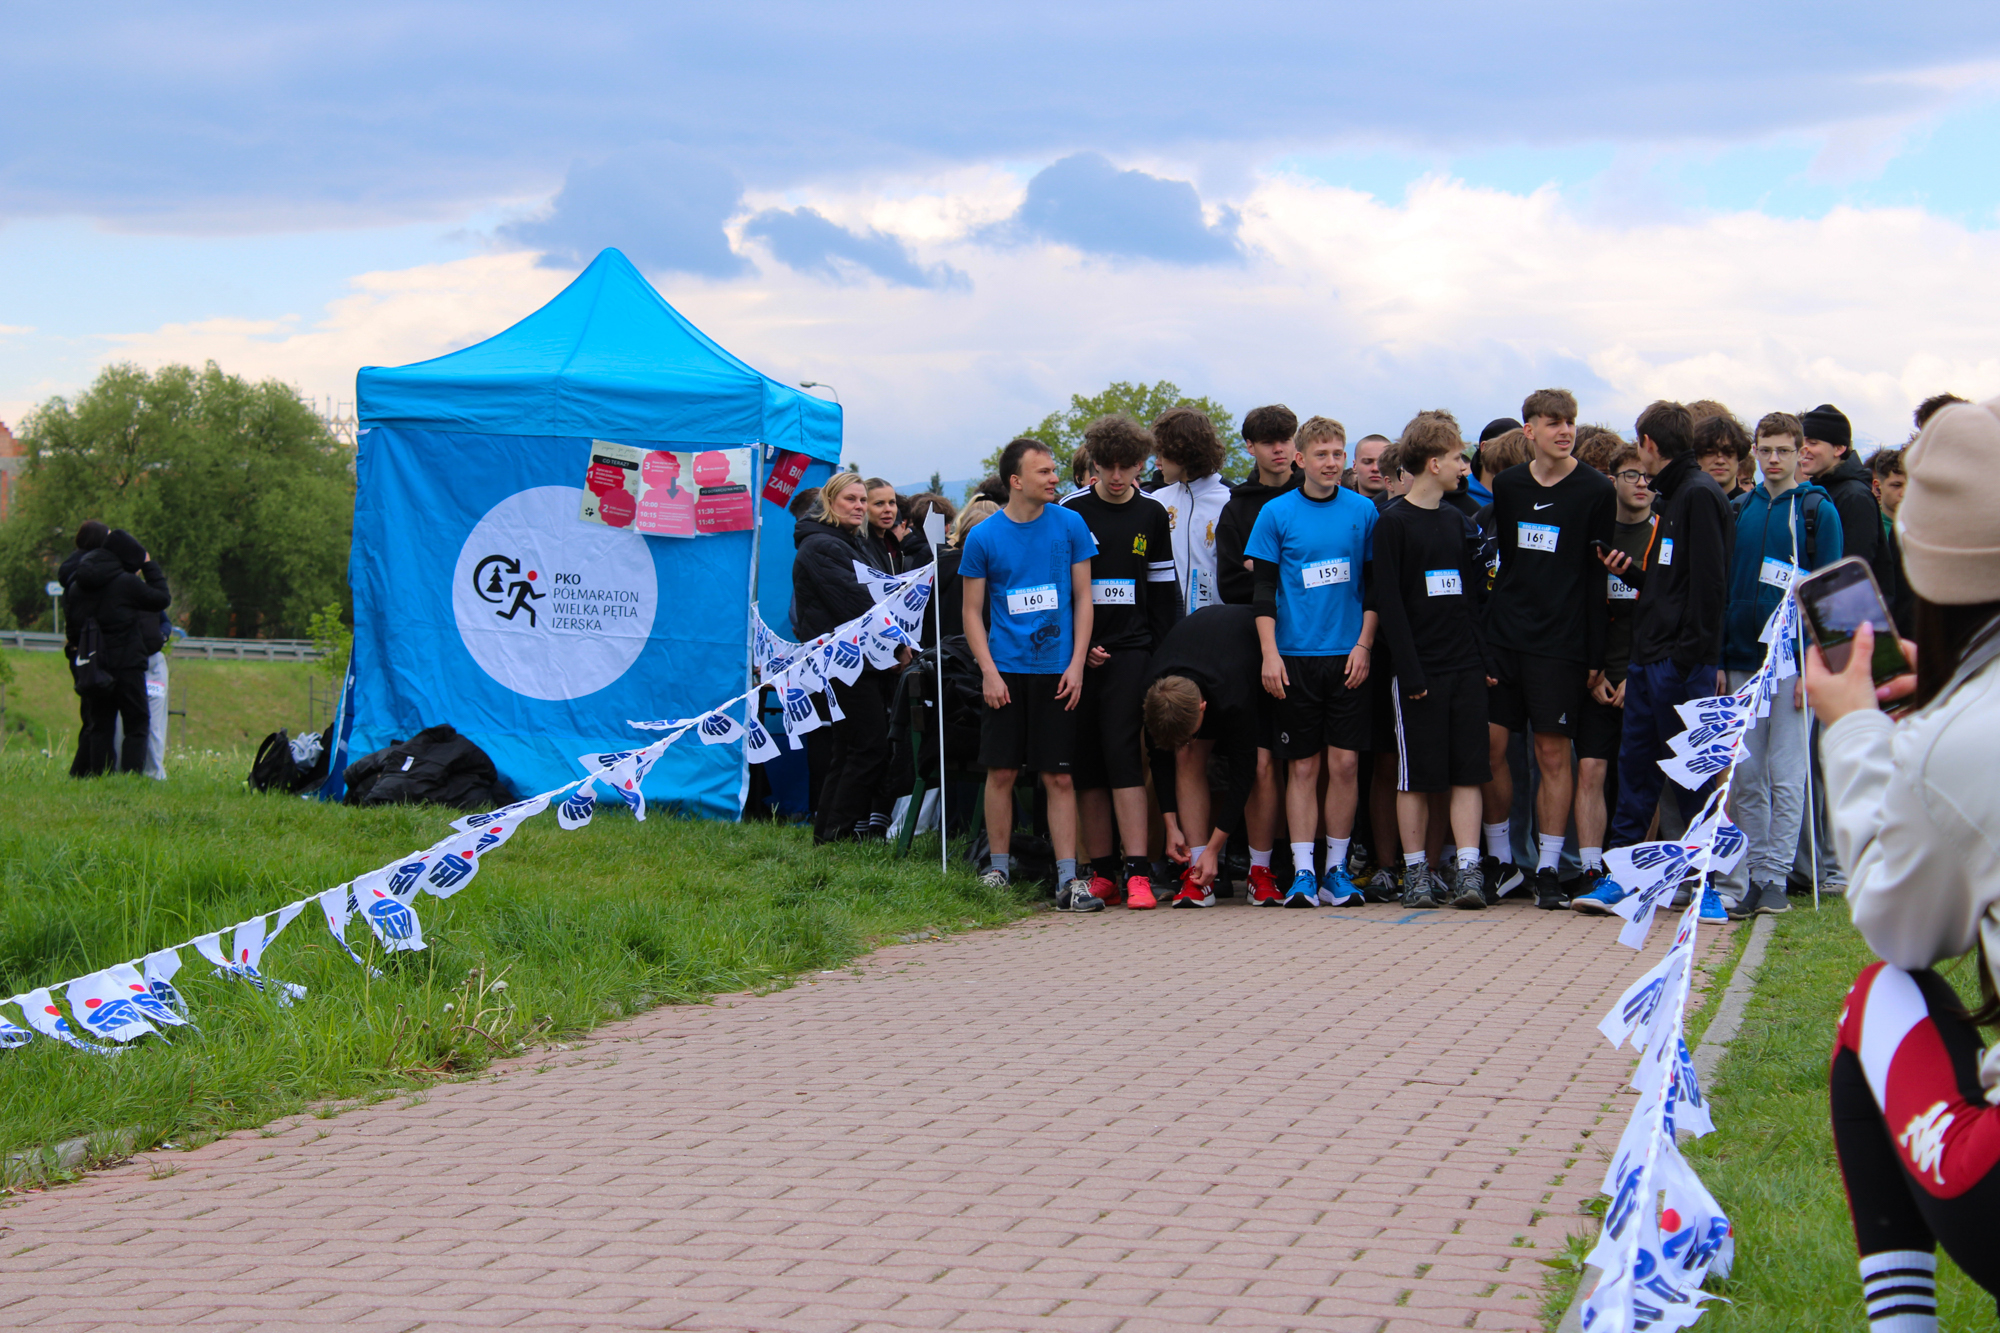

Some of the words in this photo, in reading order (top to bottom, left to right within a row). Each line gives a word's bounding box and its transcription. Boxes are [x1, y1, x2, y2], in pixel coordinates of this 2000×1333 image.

[611, 459, 629, 467] TERAZ?
[644, 462, 650, 470] 3
[696, 465, 702, 473] 4
[602, 504, 609, 512] 2
[1319, 567, 1338, 578] 159
[555, 573, 581, 585] PKO
[1442, 578, 1456, 588] 167
[553, 586, 639, 603] PÓŁMARATON
[1105, 588, 1125, 597] 096
[1199, 584, 1208, 601] 147
[1024, 594, 1043, 606] 160
[553, 603, 599, 616] WIELKA
[603, 605, 638, 620] PĘTLA
[552, 618, 602, 631] IZERSKA
